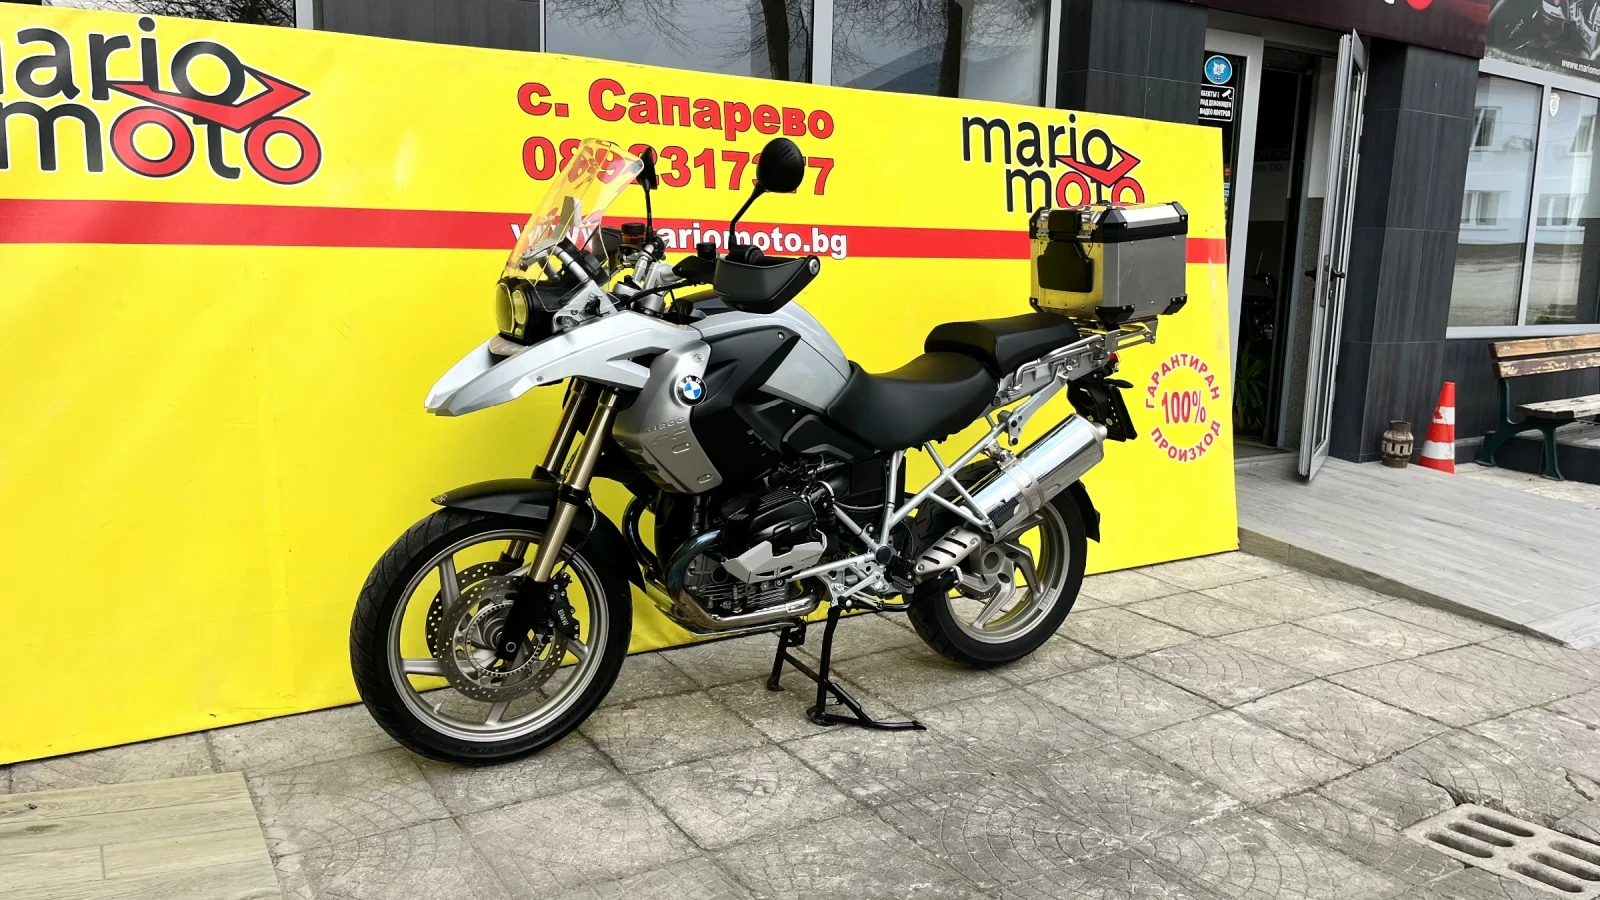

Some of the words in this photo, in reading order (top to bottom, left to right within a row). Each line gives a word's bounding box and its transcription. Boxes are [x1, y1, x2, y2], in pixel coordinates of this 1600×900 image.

[0, 16, 246, 104] ario
[517, 82, 569, 117] с.
[588, 78, 835, 140] Сапарево
[522, 136, 836, 196] 0893177
[962, 113, 1113, 169] mario
[1006, 168, 1145, 213] moto
[1146, 353, 1220, 409] ГАРАНТИРАН
[1161, 390, 1207, 424] 100%
[1151, 420, 1221, 462] ПРОИЗХОД
[557, 608, 570, 626] BMW
